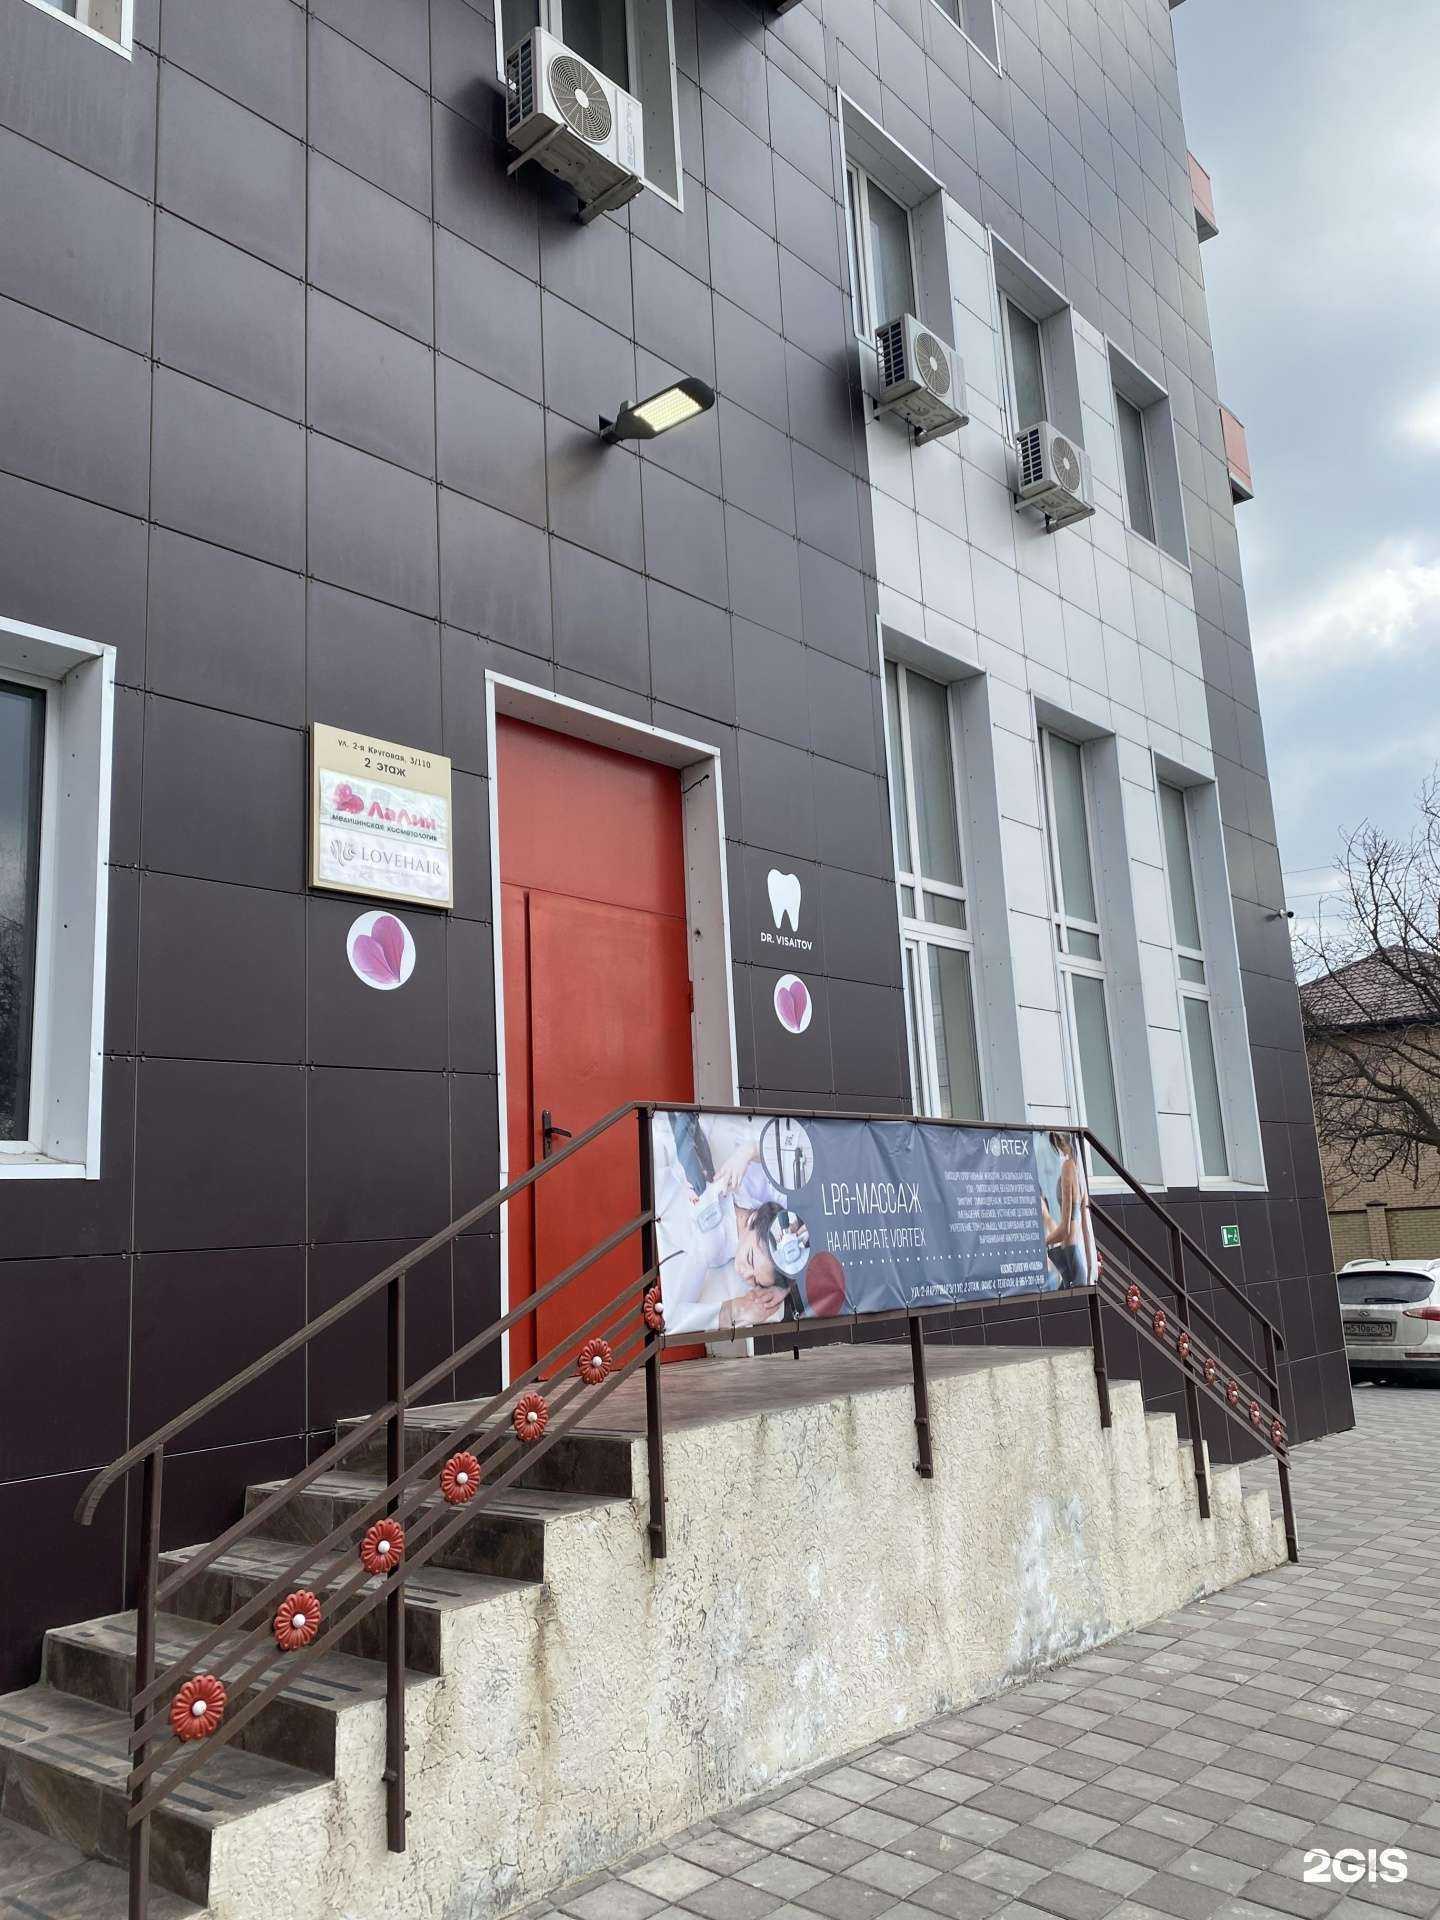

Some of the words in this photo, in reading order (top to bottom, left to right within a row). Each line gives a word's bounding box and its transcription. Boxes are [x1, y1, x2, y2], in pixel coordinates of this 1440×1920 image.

[364, 757, 371, 769] 2
[376, 762, 407, 777] этаж
[361, 847, 441, 876] LOVEHAIR
[760, 931, 775, 944] DR.
[775, 934, 813, 951] VISAITOV
[821, 1182, 923, 1215] LPG-МАССАЖ
[826, 1230, 841, 1253] НА
[842, 1227, 890, 1251] АППАРАТЕ
[889, 1226, 927, 1249] VORTEX
